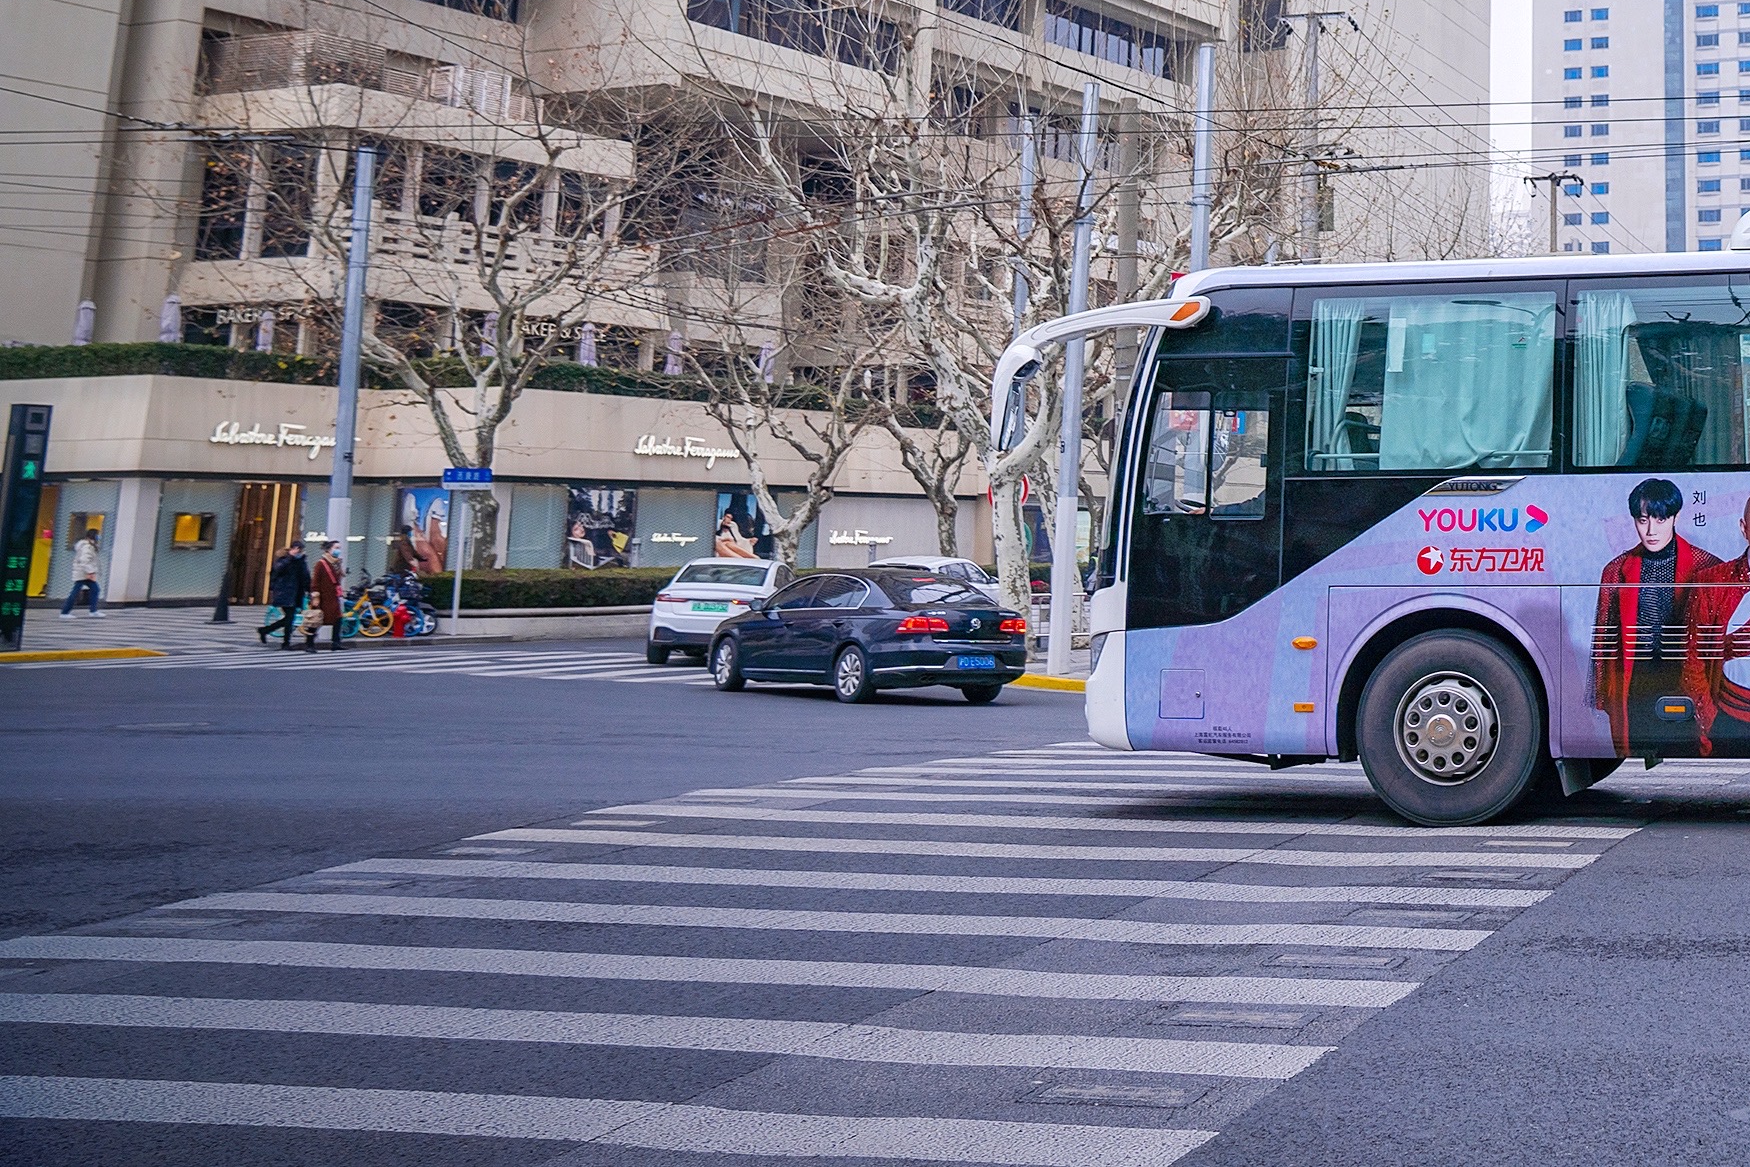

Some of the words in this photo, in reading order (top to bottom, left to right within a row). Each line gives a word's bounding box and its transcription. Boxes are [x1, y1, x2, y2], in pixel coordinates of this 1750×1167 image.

[633, 434, 684, 456] Salvatore
[1418, 508, 1519, 532] YOUKU
[1692, 490, 1707, 527] 刘也
[1449, 547, 1545, 572] 东方卫视
